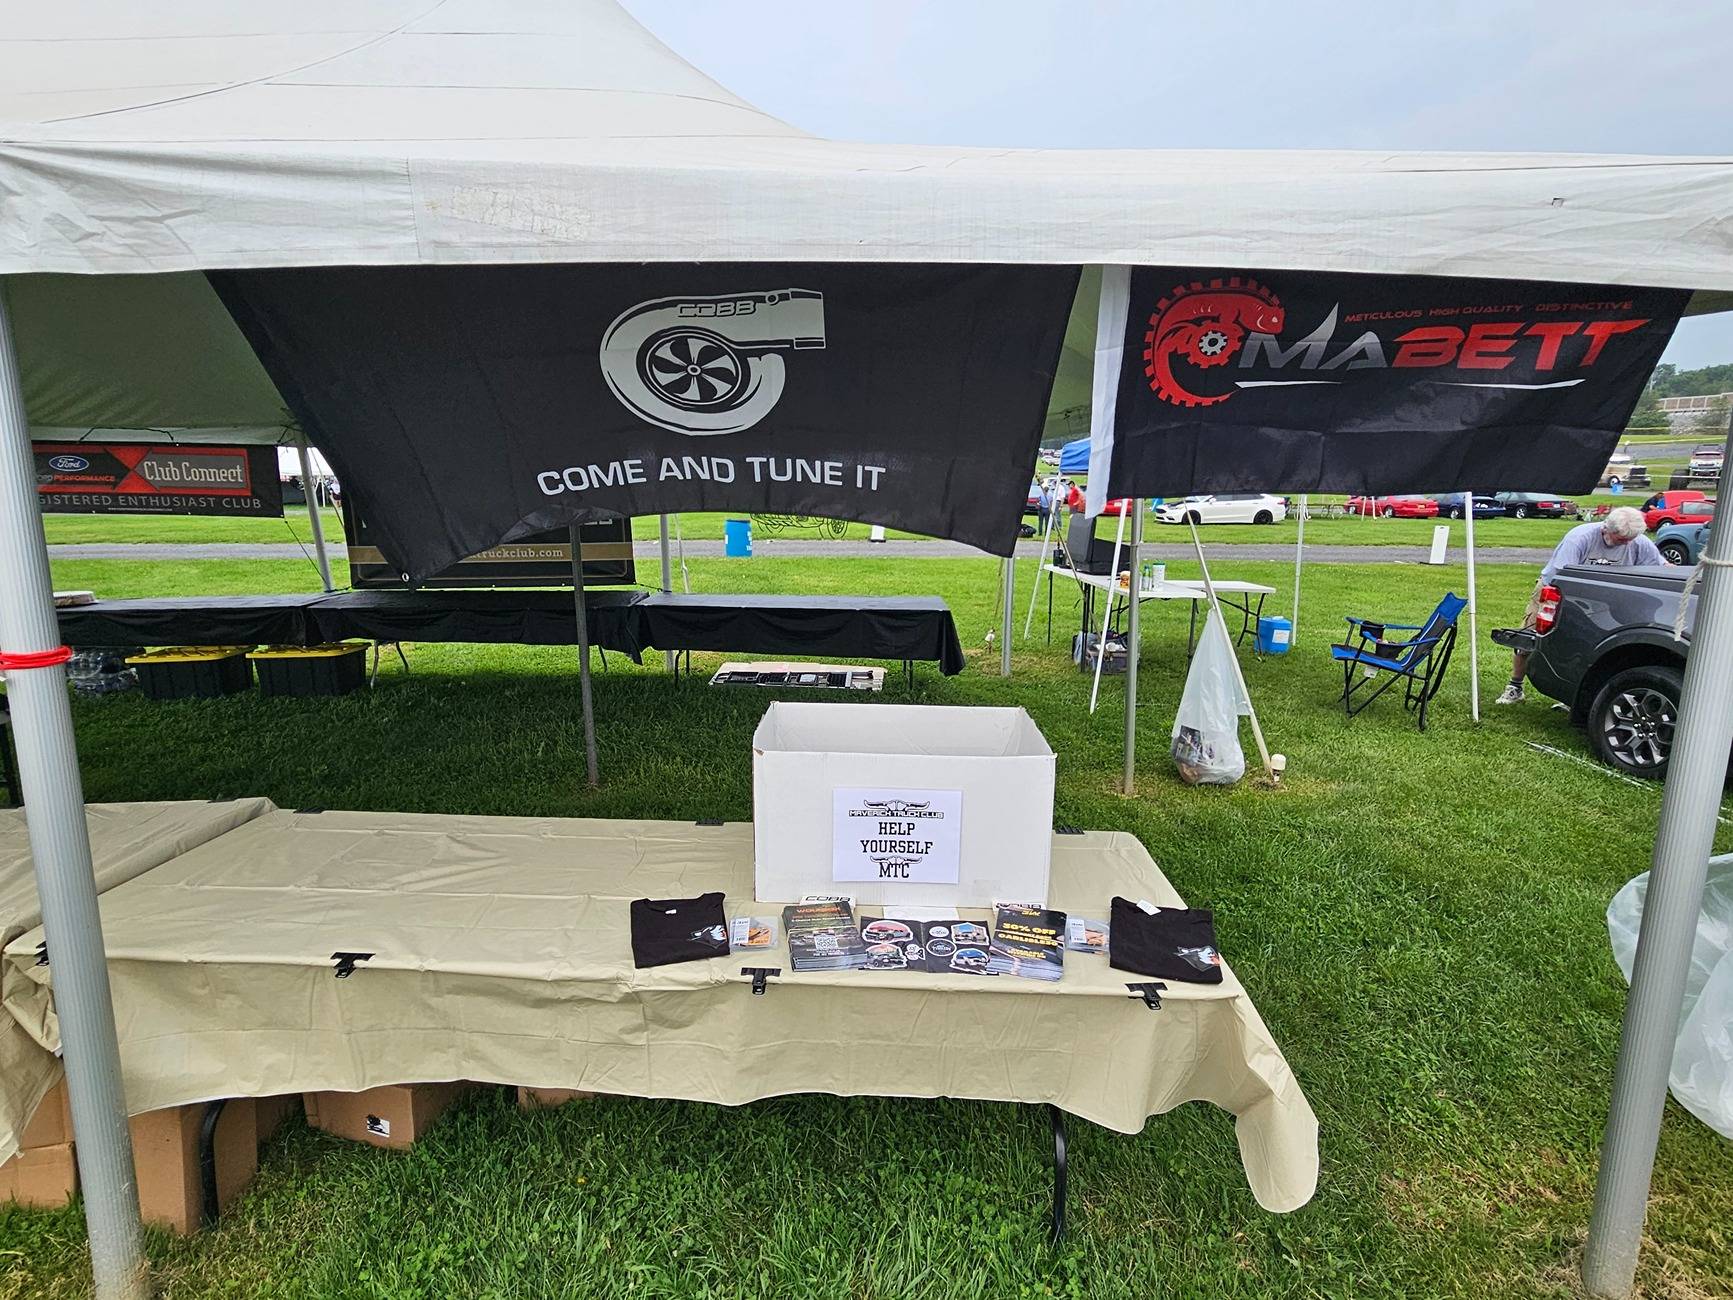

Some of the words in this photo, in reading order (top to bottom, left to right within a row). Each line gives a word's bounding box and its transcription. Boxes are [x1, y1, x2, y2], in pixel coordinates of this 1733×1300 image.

[677, 301, 757, 317] COBB
[1344, 310, 1423, 322] METICULOUS
[1428, 307, 1460, 316] HIGH
[1462, 304, 1523, 315] QUALITY
[1535, 301, 1633, 311] DISTINCTIVE
[1238, 301, 1653, 371] MABETT
[143, 461, 181, 482] Club
[183, 462, 243, 482] Connect
[536, 459, 647, 495] COME
[659, 456, 735, 483] AND
[745, 456, 843, 486] TUNE
[856, 464, 886, 491] IT
[39, 494, 112, 506] GISTERED
[119, 496, 216, 508] ENTHUSIAST
[222, 498, 262, 509] CLUB
[878, 822, 915, 835] HELP
[860, 840, 933, 854] YOURSELF
[879, 862, 909, 878] MTC
